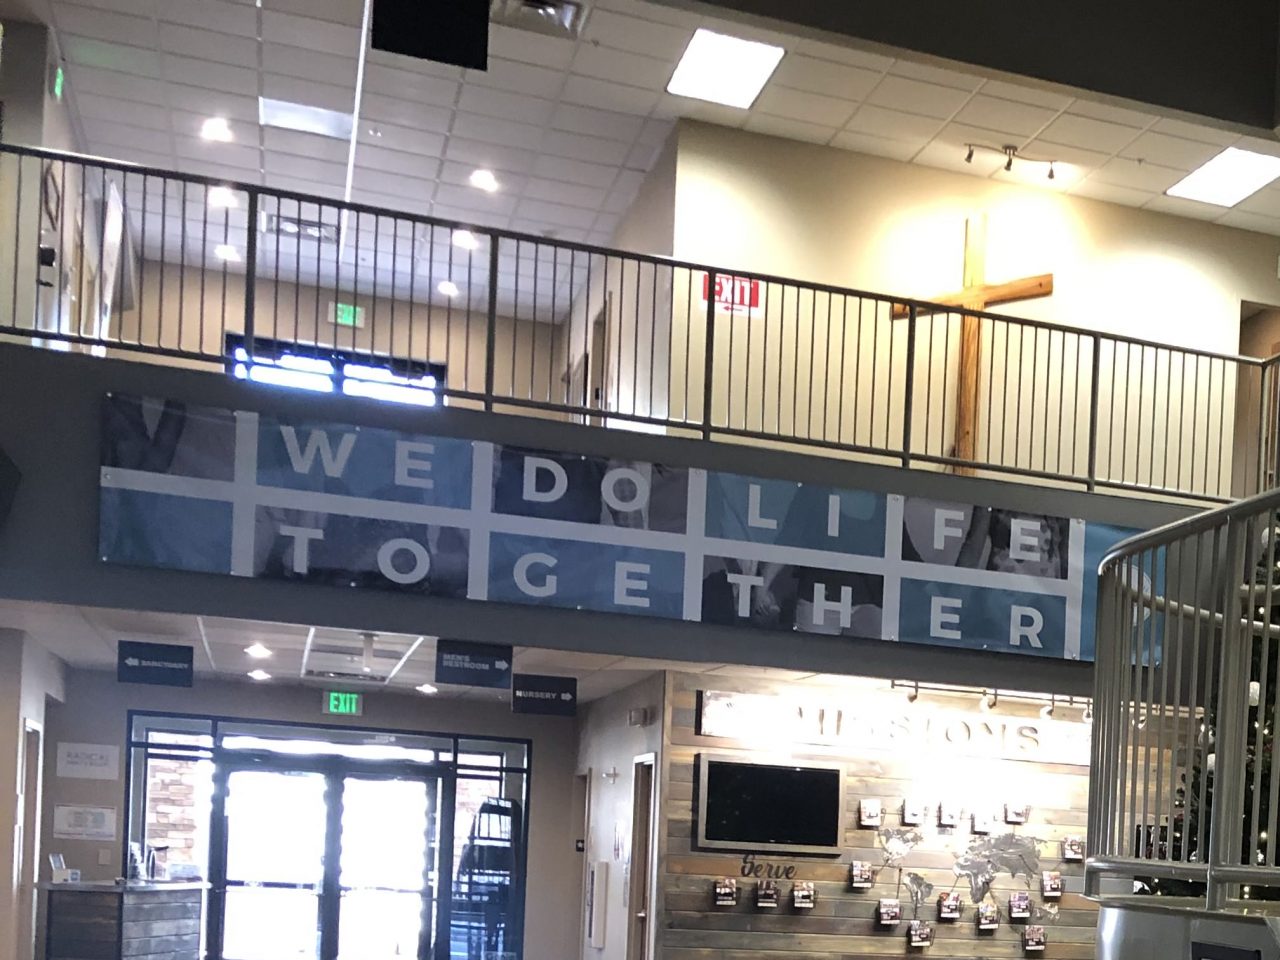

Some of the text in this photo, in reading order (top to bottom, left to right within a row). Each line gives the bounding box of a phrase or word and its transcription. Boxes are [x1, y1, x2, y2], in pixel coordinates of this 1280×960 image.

[711, 276, 755, 307] EXIT
[279, 425, 1041, 562] WE DO LIFE
[279, 525, 1044, 648] TOGETHER
[329, 692, 358, 713] EXIT
[516, 690, 557, 699] NURSERY
[741, 854, 798, 880] Serve
